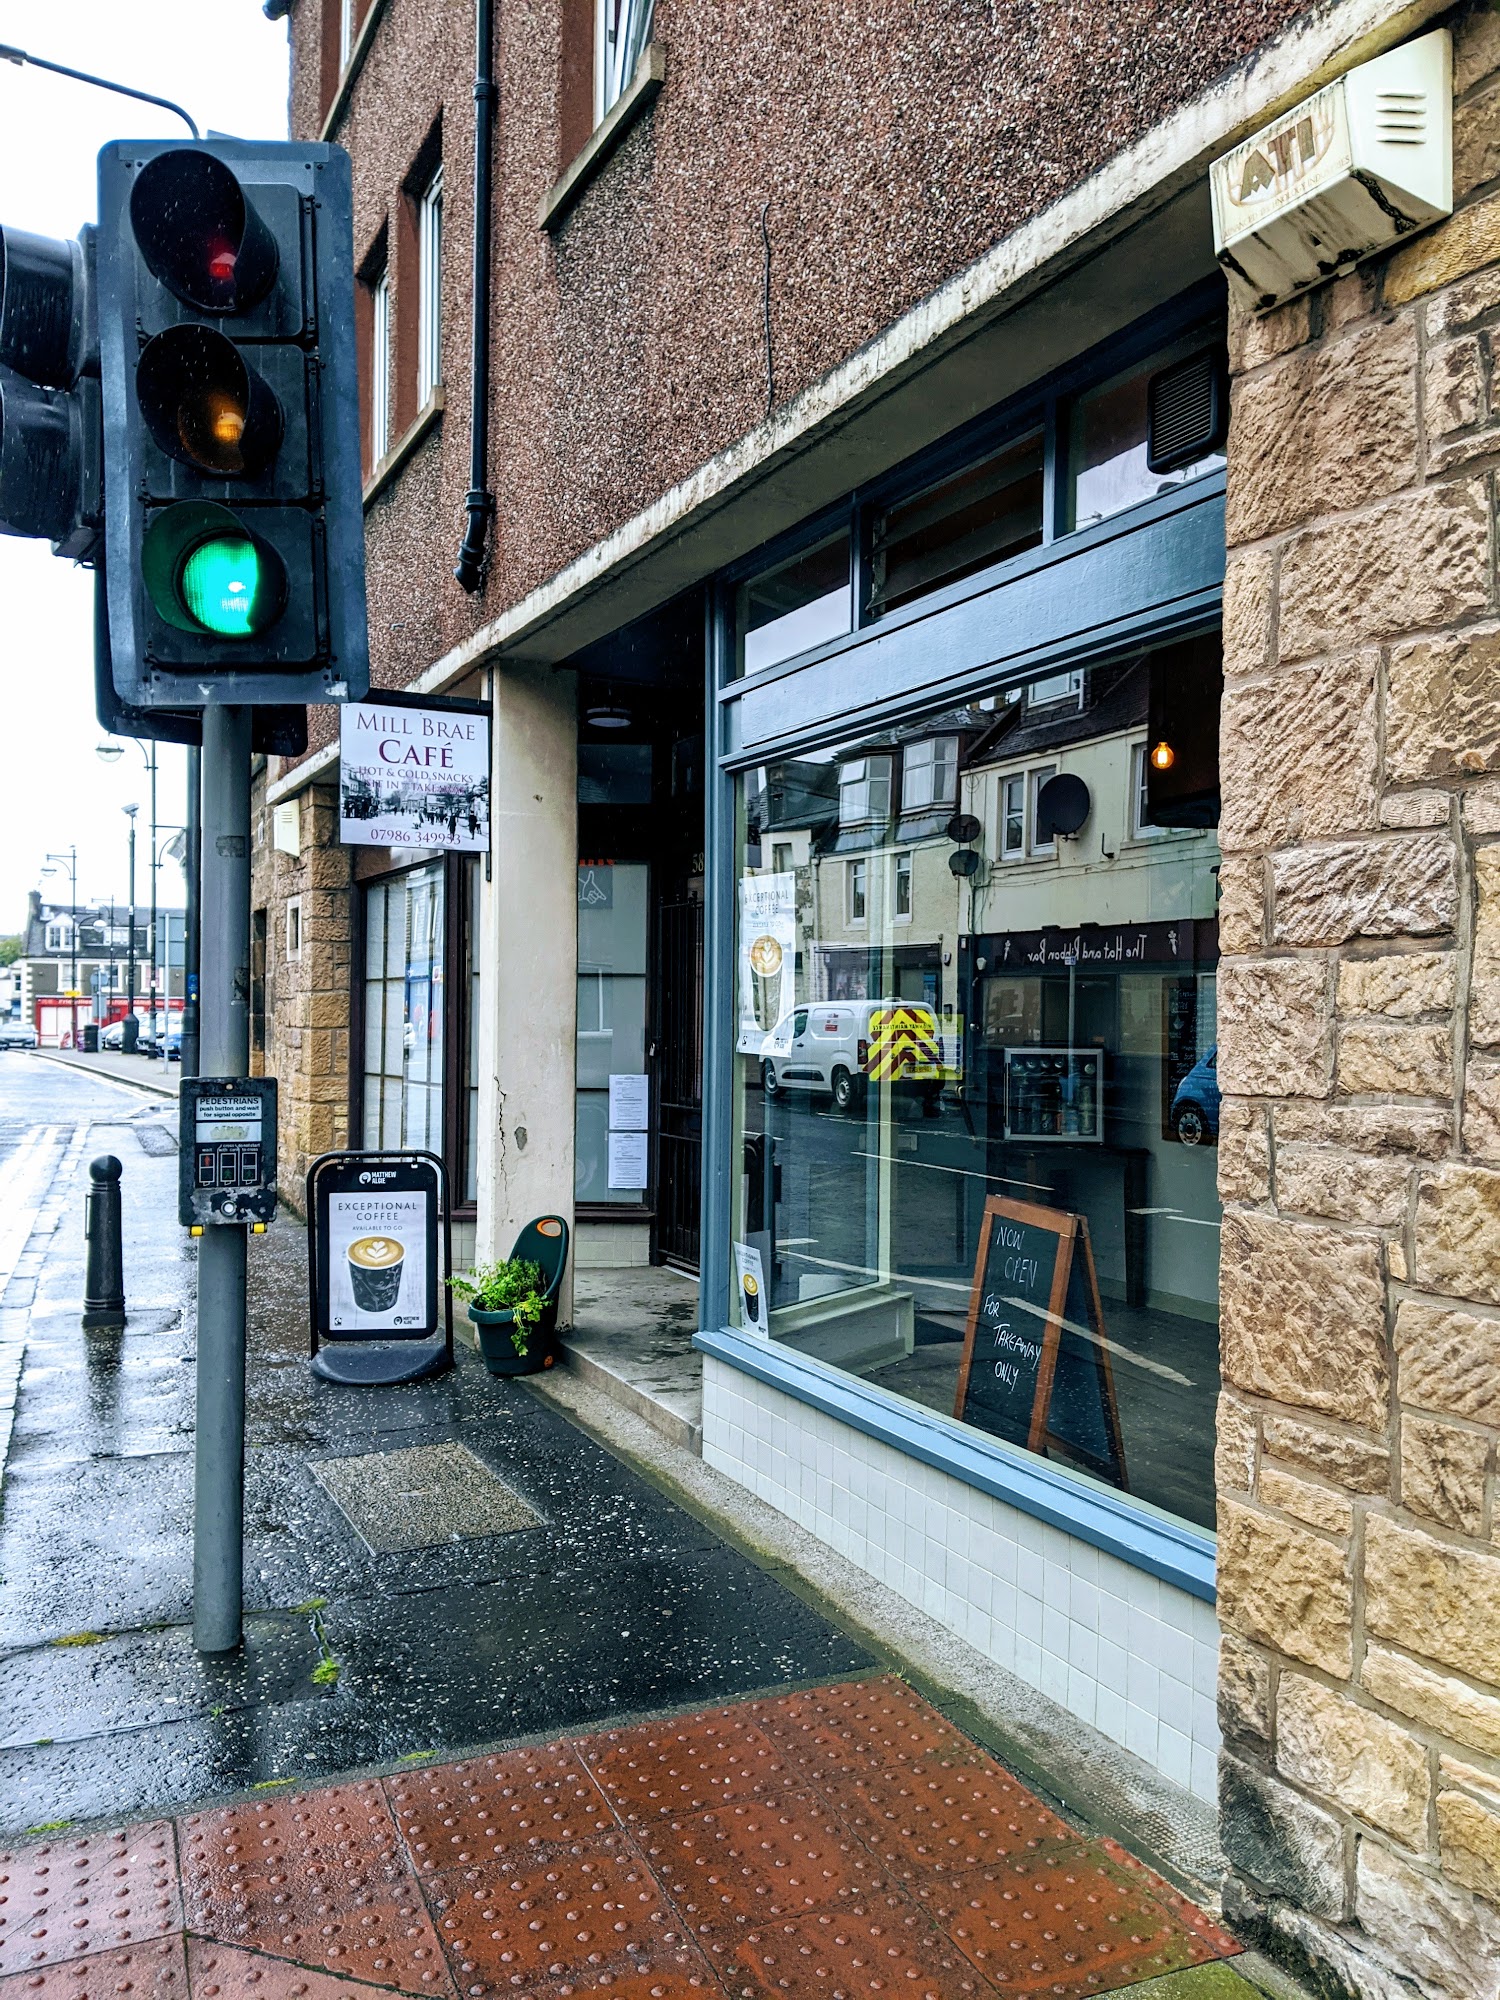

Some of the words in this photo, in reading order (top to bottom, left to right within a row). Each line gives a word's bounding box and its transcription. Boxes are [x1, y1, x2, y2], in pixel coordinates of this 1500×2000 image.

[356, 711, 413, 735] MILL
[422, 717, 476, 741] BRAE
[378, 739, 454, 769] CAFÉ
[358, 766, 384, 777] HOT
[386, 768, 395, 777] &
[432, 772, 474, 784] SNACKS
[386, 780, 399, 789] IN
[370, 828, 411, 842] 07986
[199, 1097, 259, 1105] PEDESTRIANS
[338, 1202, 417, 1211] EXCEPTIONAL
[356, 1212, 399, 1221] COFFEE
[996, 1226, 1026, 1251] NOW
[1004, 1256, 1038, 1288] OPEN
[983, 1293, 1000, 1318] FOR
[993, 1323, 1042, 1371] TAKEAWAY
[994, 1361, 1020, 1392] ONLY
